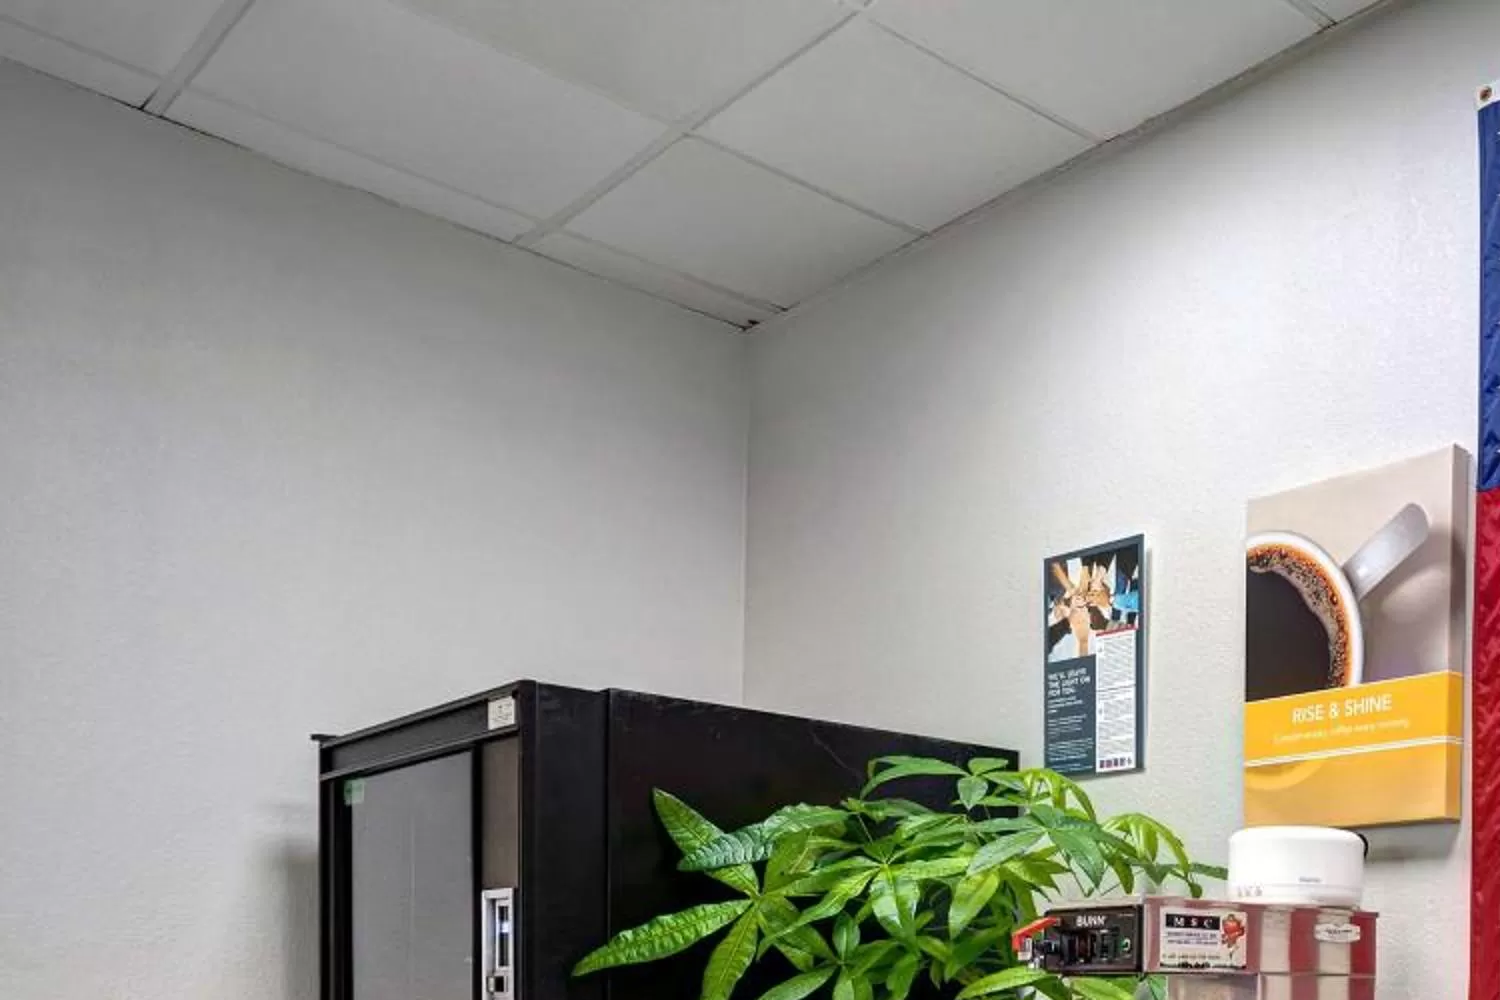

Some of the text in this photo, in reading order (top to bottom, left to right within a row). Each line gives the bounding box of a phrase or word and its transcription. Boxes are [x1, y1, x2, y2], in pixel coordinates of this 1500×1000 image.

[1291, 693, 1393, 726] RISE & SHINE
[1076, 914, 1107, 928] BUNN
